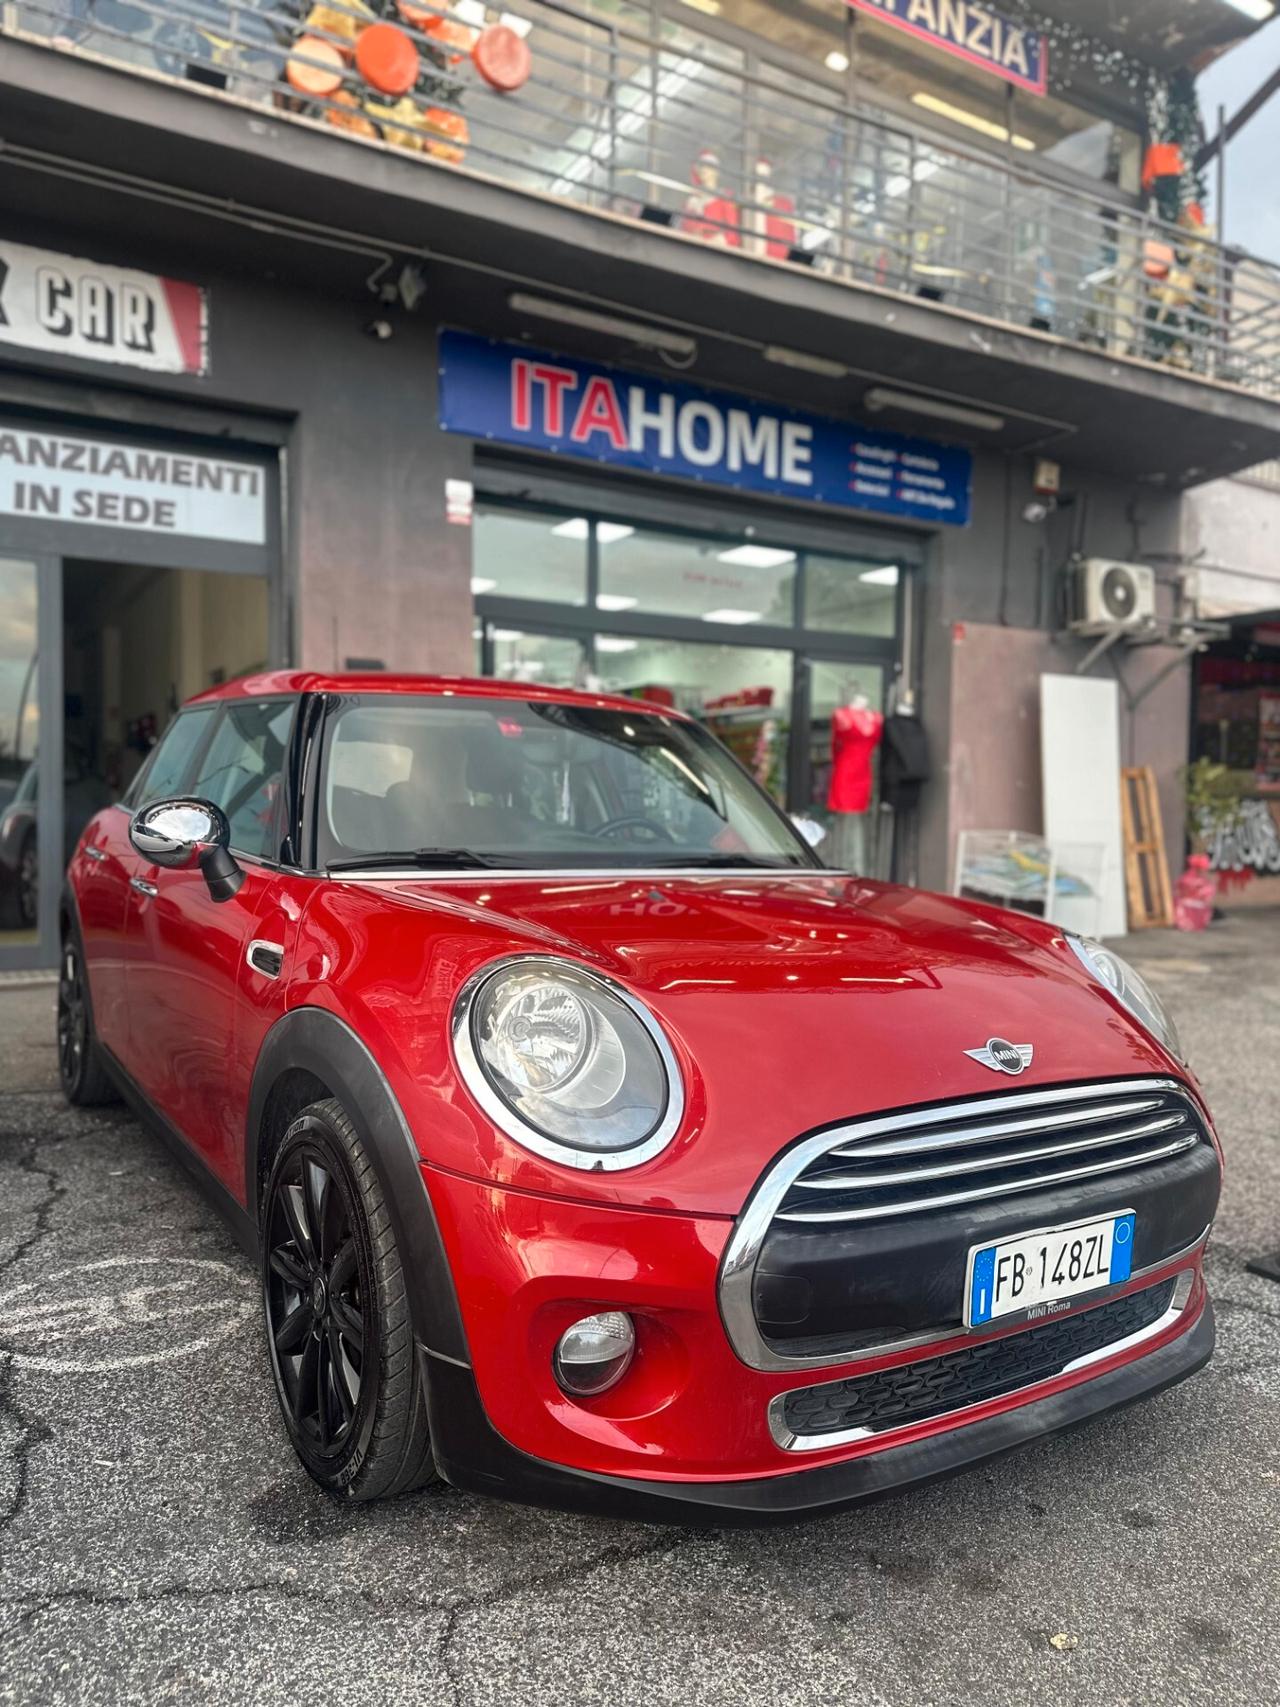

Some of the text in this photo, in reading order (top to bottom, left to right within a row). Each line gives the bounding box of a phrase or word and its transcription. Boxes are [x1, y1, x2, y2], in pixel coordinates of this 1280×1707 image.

[36, 265, 155, 354] CAR
[511, 358, 813, 486] ITAHOME
[14, 481, 177, 528] IN SEDE
[994, 1049, 1019, 1061] MINI
[996, 1234, 1109, 1303] FB 148ZL
[1027, 1301, 1071, 1320] MINI Roma
